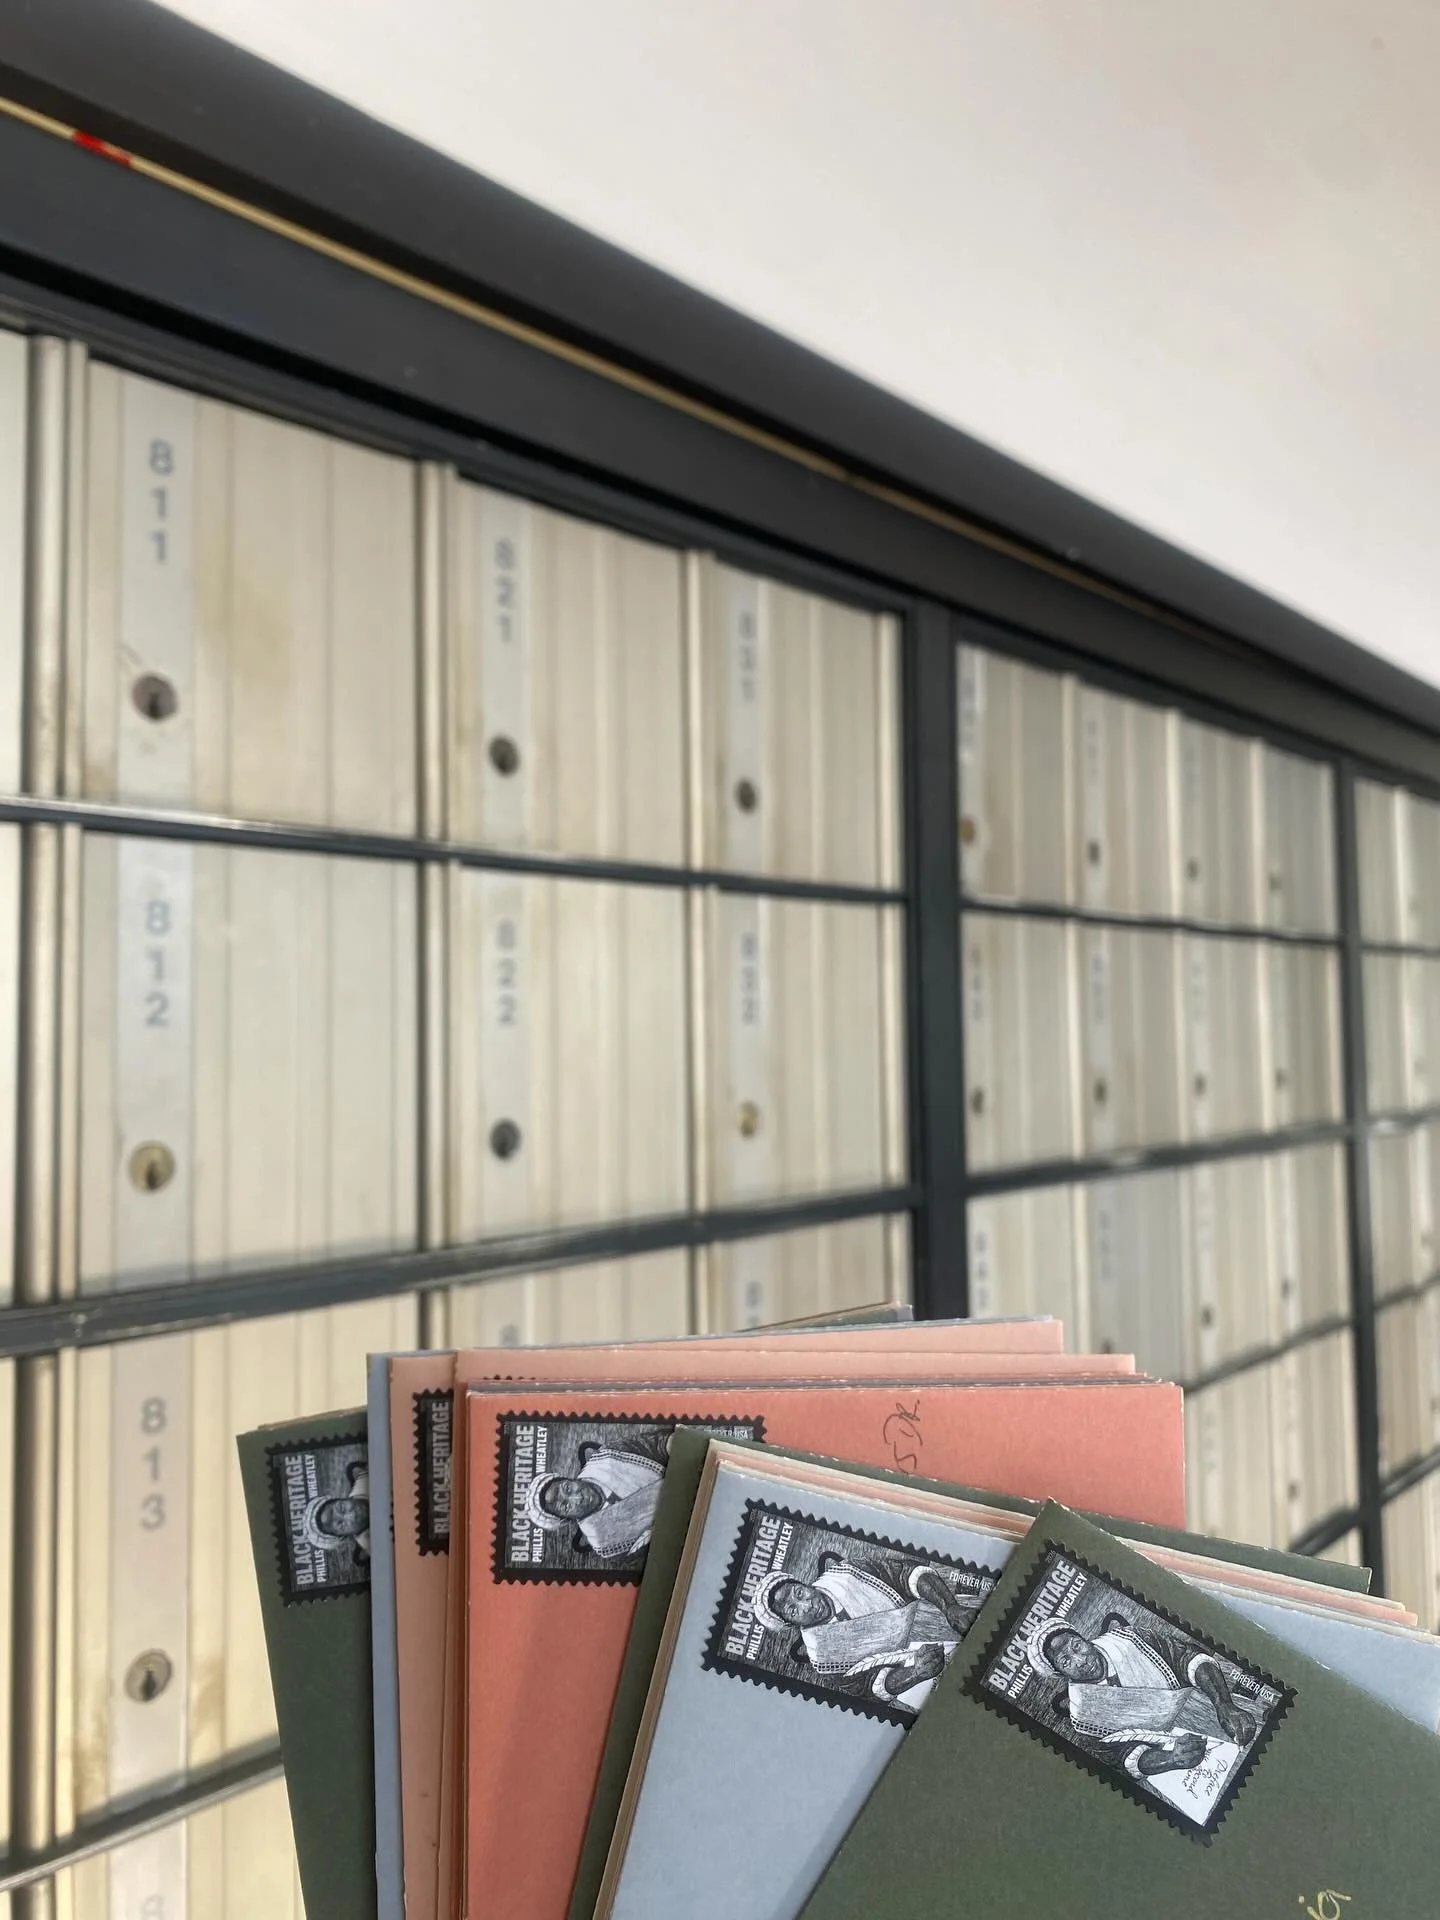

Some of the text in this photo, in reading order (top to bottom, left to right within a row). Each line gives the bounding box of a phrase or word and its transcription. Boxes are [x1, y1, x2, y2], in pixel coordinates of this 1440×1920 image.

[148, 438, 175, 565] 811
[145, 900, 171, 1028] 812
[140, 1397, 168, 1532] 813
[285, 1455, 315, 1585] BLACK HERITAGE
[304, 1454, 328, 1583] PHILLIS WHEATLEY
[431, 1401, 451, 1534] BLACK HERITAGE
[511, 1425, 535, 1562] BLACK HERITAGE
[532, 1425, 548, 1563] PHILLIS WHEATLEY
[725, 1515, 781, 1656] BLACK HERITAGE
[746, 1522, 794, 1660] PHILLIS WHEATLEY
[988, 1560, 1076, 1691] BLACK HERITAGE
[1007, 1572, 1088, 1699] PHILLIS WHEATLEY
